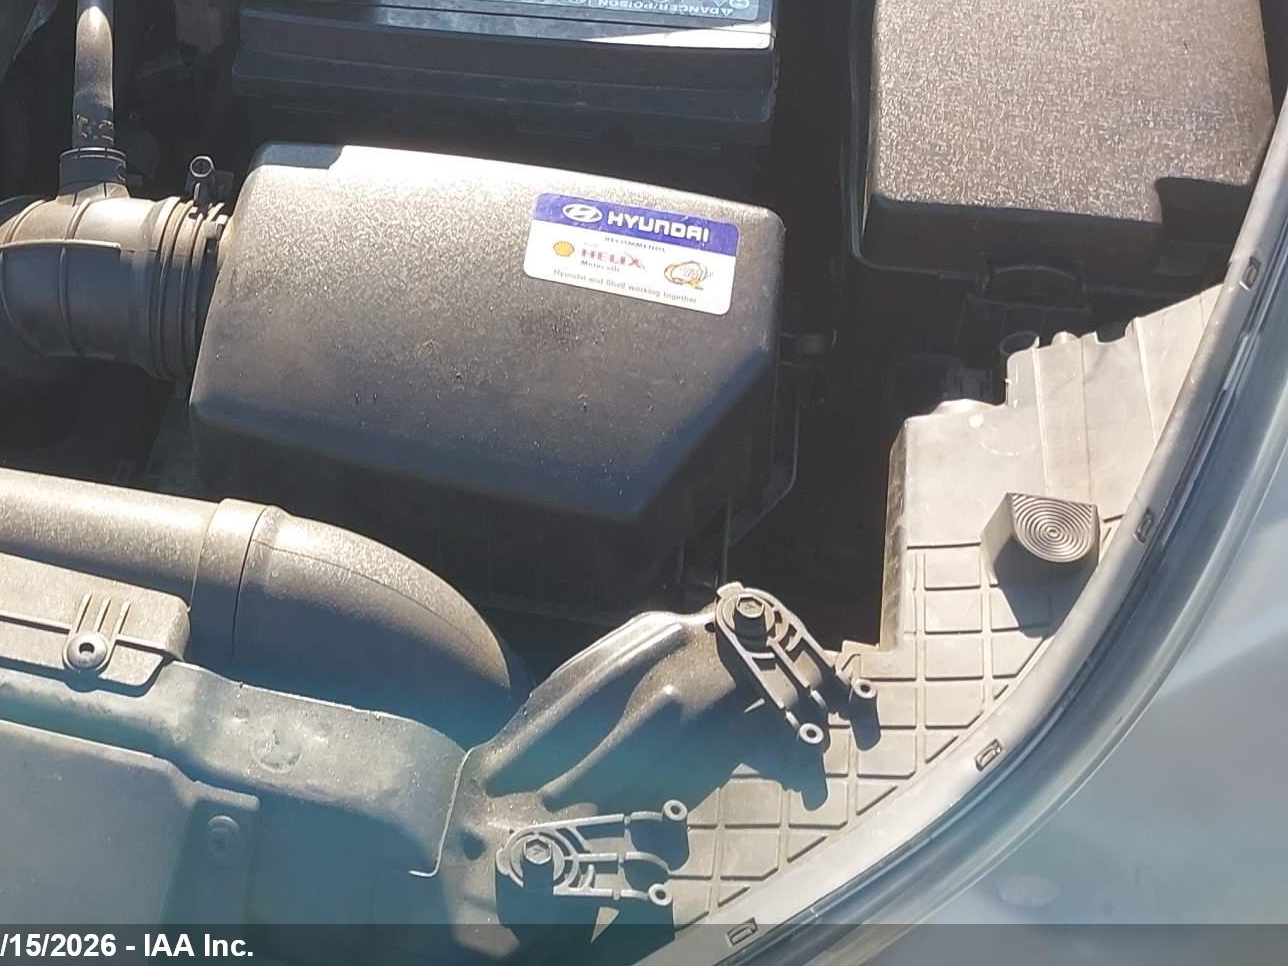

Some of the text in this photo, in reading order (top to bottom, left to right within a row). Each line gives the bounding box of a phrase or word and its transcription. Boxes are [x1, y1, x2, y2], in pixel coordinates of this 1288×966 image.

[607, 211, 711, 243] HYUNDAI
[580, 247, 646, 270] HELIX
[553, 269, 587, 283] Hyundai
